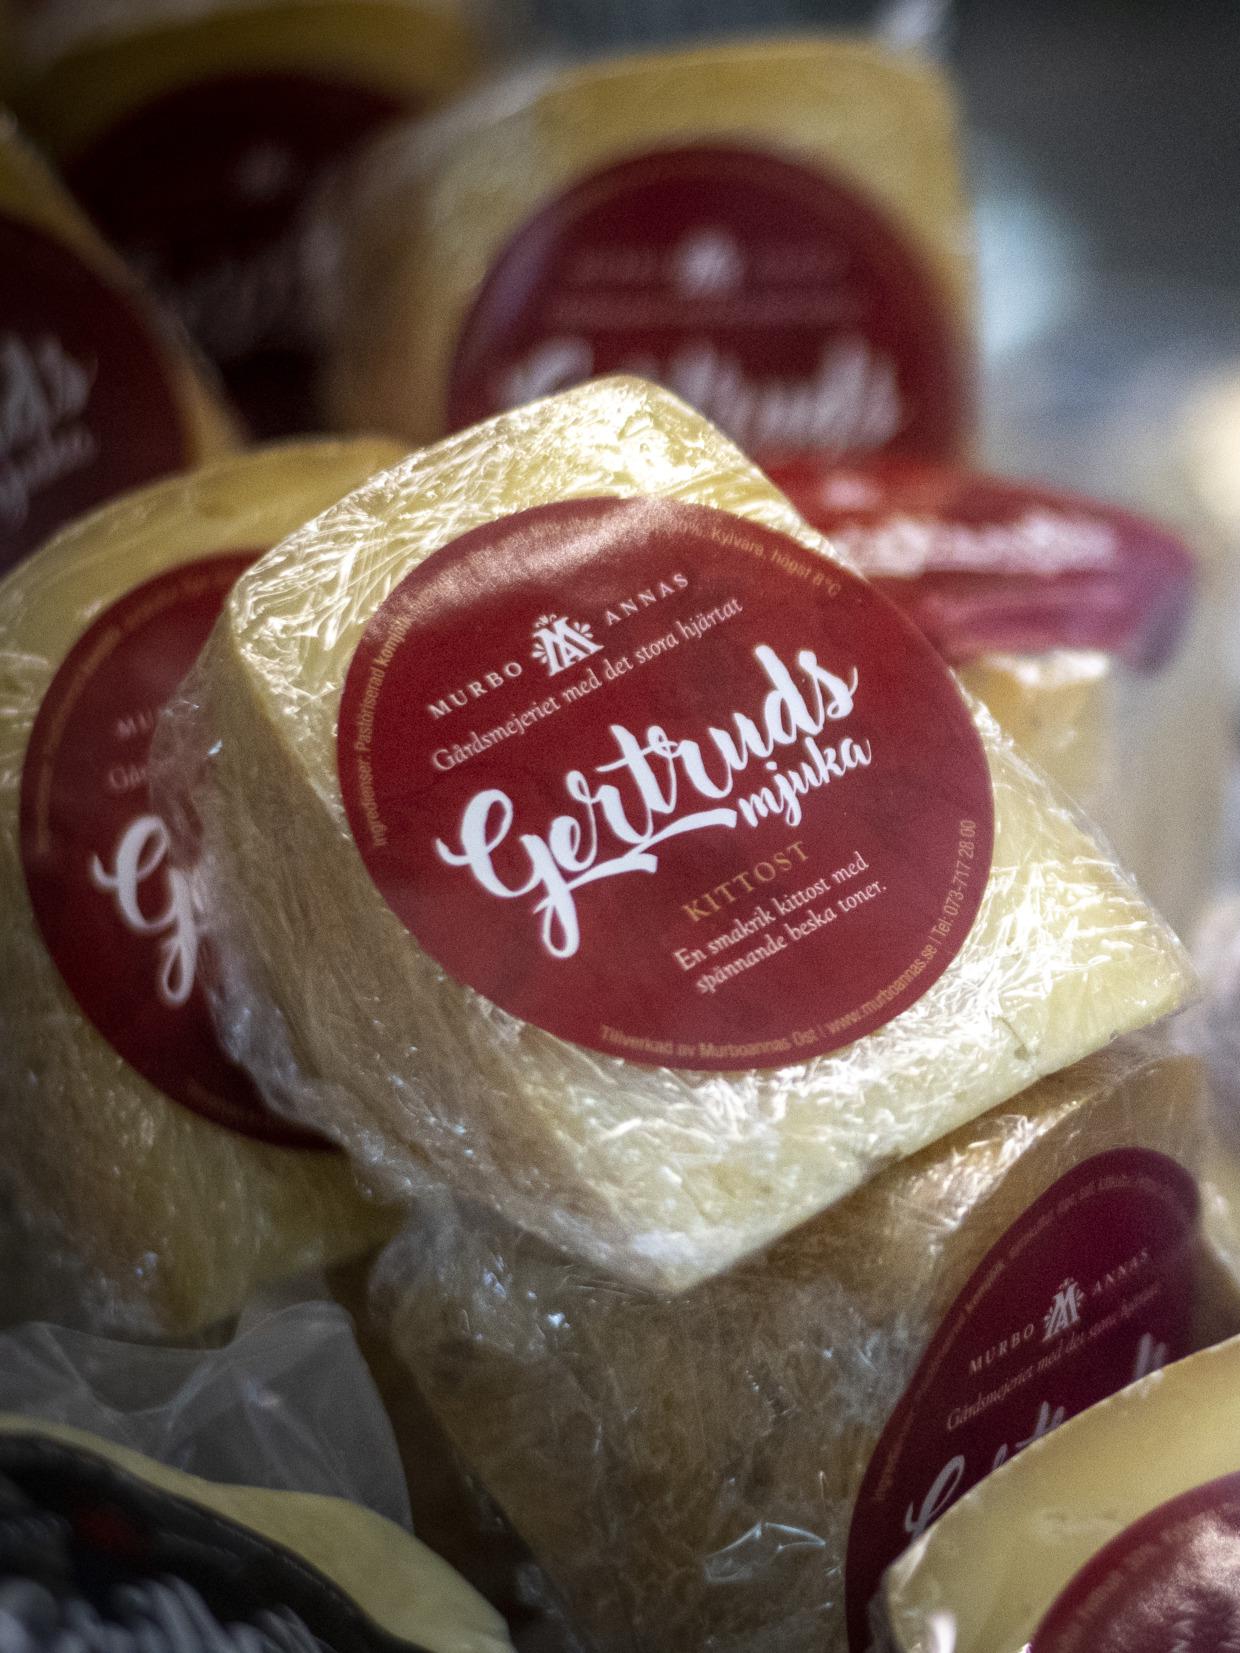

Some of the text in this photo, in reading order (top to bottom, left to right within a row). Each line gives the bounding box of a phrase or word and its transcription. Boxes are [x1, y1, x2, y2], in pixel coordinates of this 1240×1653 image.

[427, 661, 523, 721] MURBO
[604, 572, 689, 626] ANNAS
[431, 598, 744, 772] Gårdsmejeriet med det stora hjärtat
[435, 645, 858, 959] Gertruds
[738, 736, 872, 827] mjuka
[957, 840, 975, 859] 28
[960, 818, 977, 838] 00
[673, 851, 870, 972] En smakrik kittost med
[682, 841, 809, 923] KITTOST
[943, 860, 972, 917] 073-717
[695, 878, 888, 995] spännande beska toner.
[931, 916, 954, 938] Tel:
[967, 1322, 1036, 1376] MURBO
